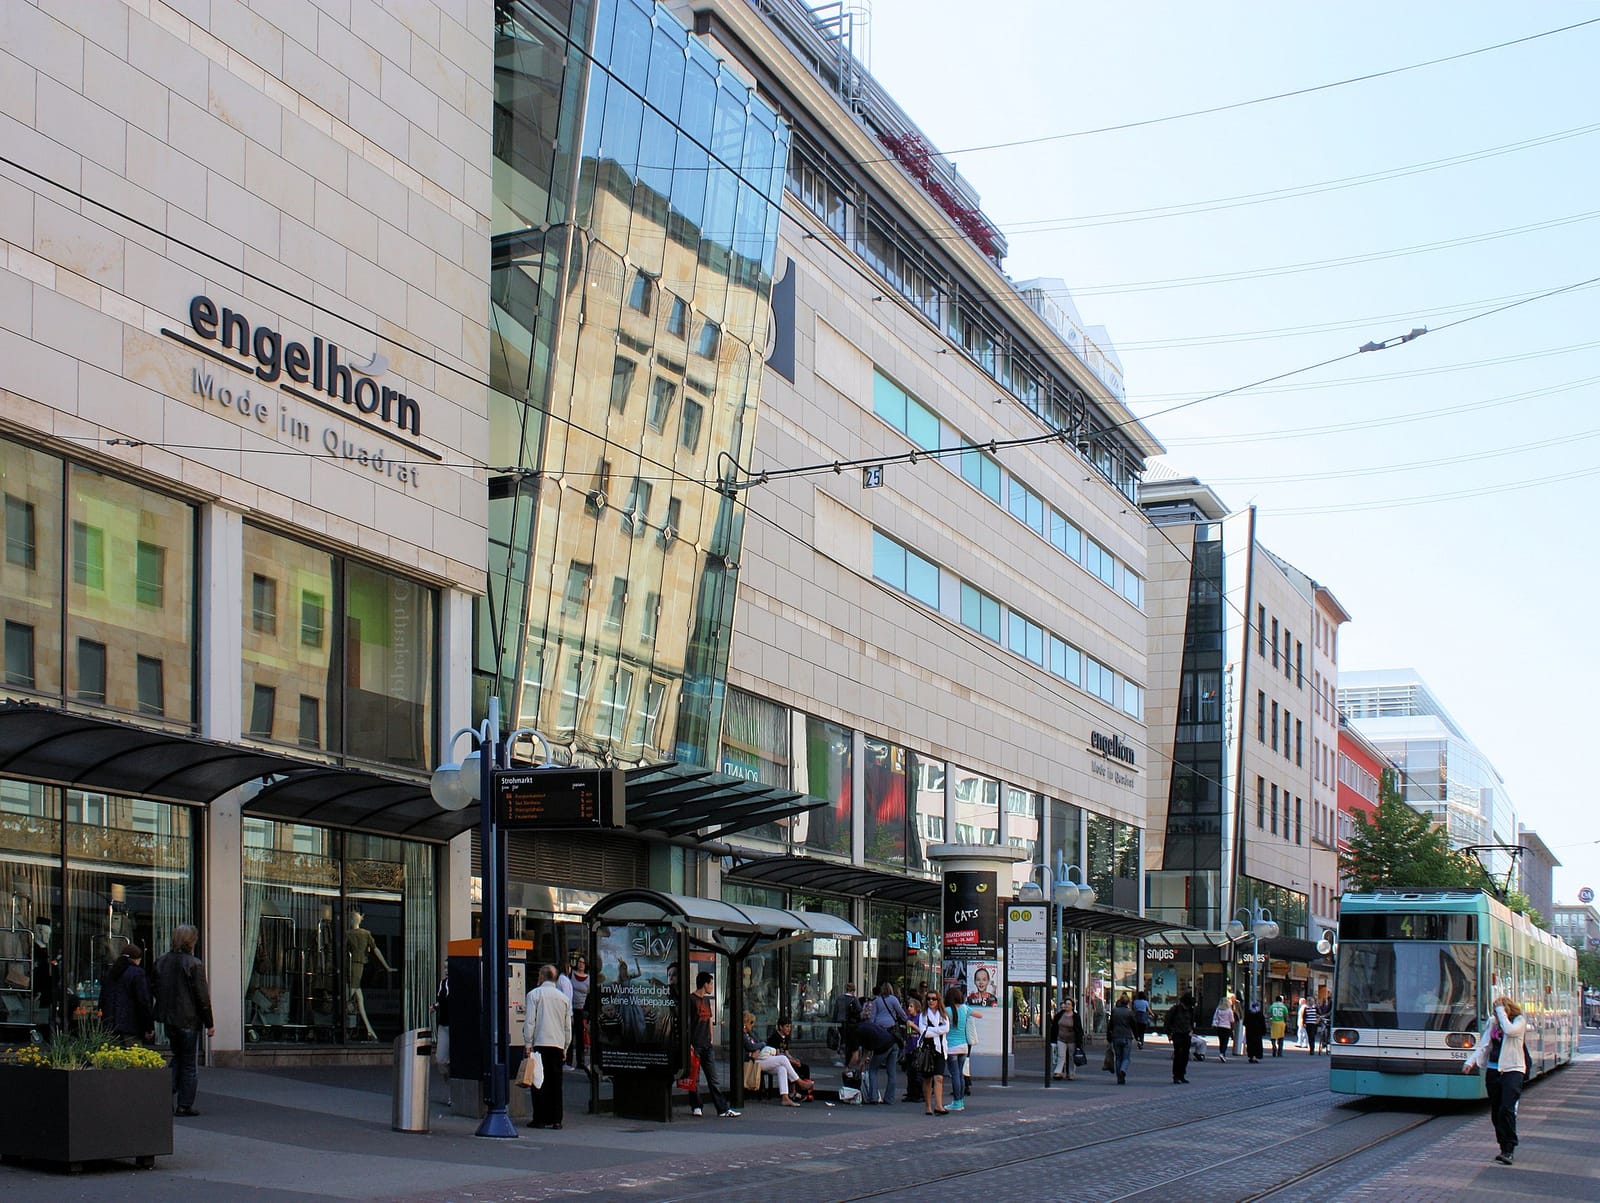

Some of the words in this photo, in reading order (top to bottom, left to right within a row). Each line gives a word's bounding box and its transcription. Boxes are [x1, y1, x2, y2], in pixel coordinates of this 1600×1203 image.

[190, 295, 421, 436] engelhorn
[192, 368, 269, 423] Mode
[281, 406, 310, 442] im
[322, 427, 420, 488] Quadrat
[866, 470, 880, 486] 25
[1091, 730, 1135, 765] engelhorn
[501, 777, 533, 785] Strohmarkt
[954, 909, 979, 924] CATS
[1400, 916, 1413, 937] 4
[632, 928, 674, 963] sky
[1146, 948, 1175, 961] snipes
[601, 984, 612, 994] Im
[612, 984, 656, 995] Wunderland
[657, 985, 671, 997] gibt
[610, 996, 629, 1005] keine
[630, 996, 676, 1008] Werbepause.
